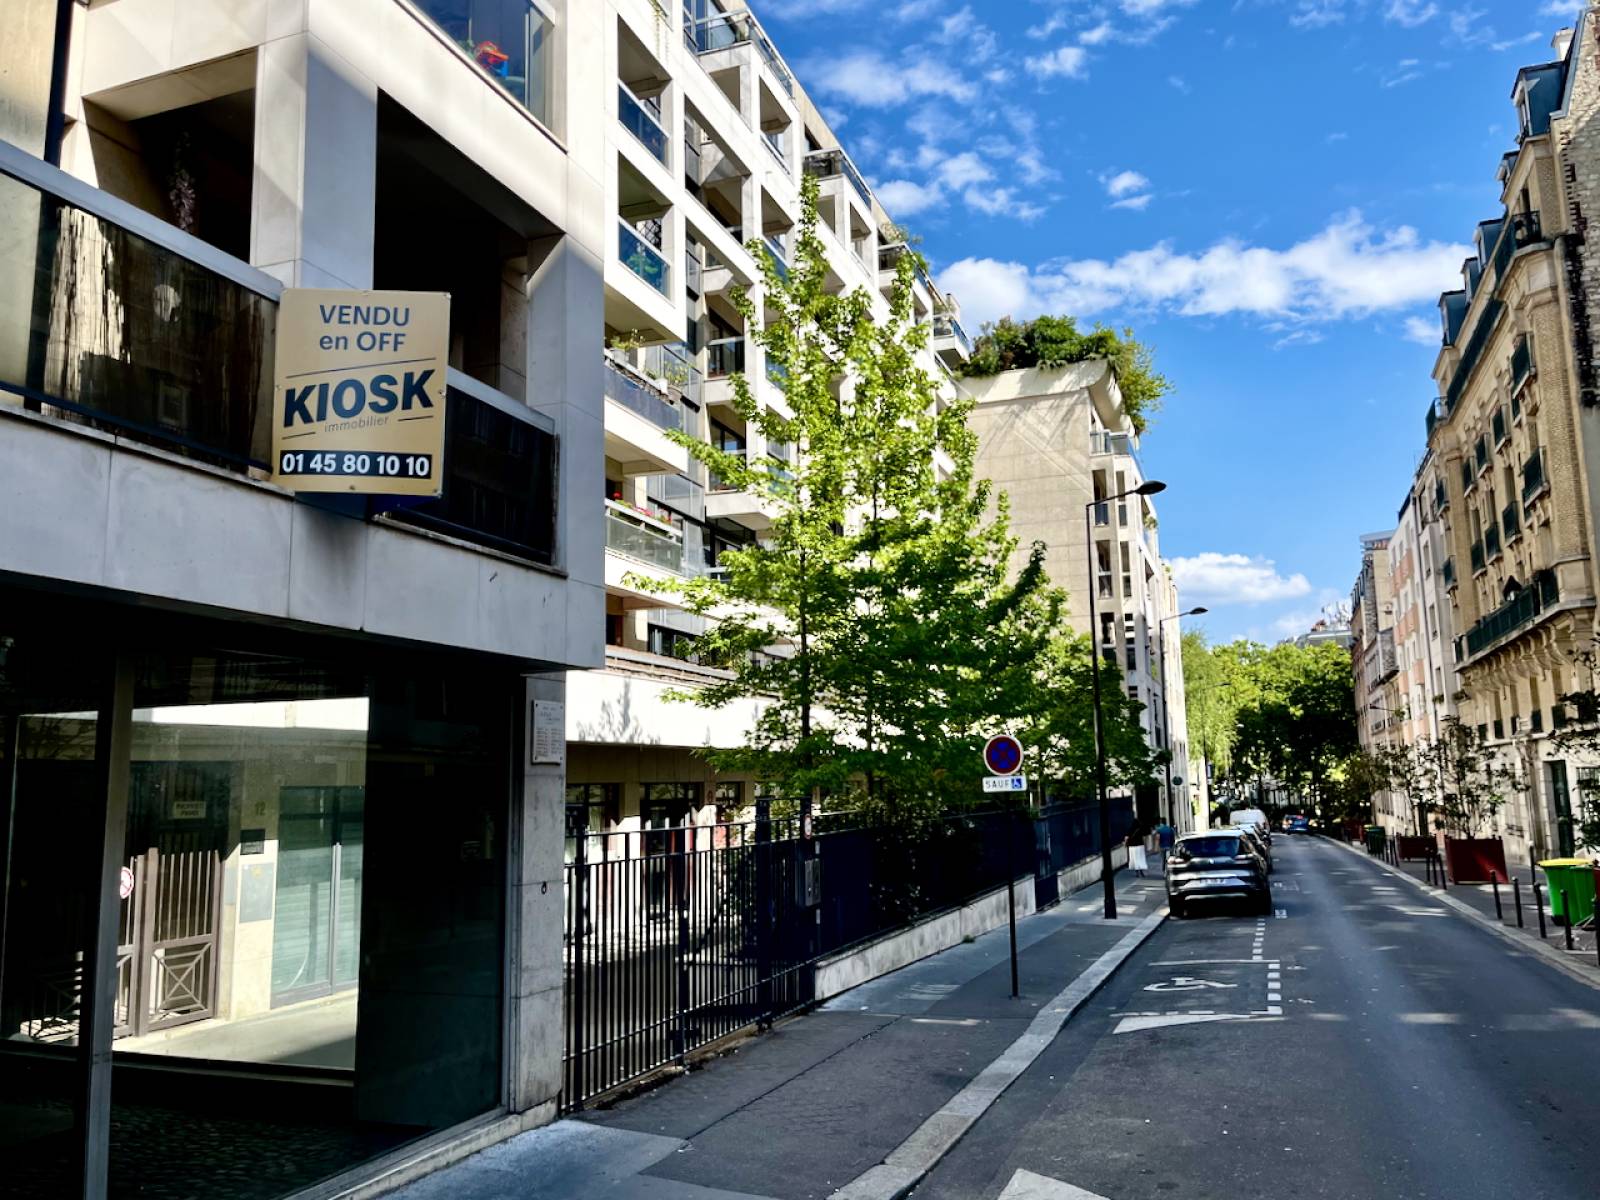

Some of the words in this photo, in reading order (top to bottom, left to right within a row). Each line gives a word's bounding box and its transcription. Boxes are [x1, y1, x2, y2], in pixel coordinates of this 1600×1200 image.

[319, 304, 410, 327] VENDU
[319, 334, 348, 350] en
[356, 331, 407, 352] OFF
[283, 369, 436, 428] KIOSK
[324, 415, 390, 433] immobilier
[282, 453, 304, 473] 01
[309, 453, 337, 473] 45
[342, 454, 371, 474] 80
[376, 455, 401, 475] 10
[405, 456, 430, 476] 10
[985, 779, 1009, 789] SAUF
